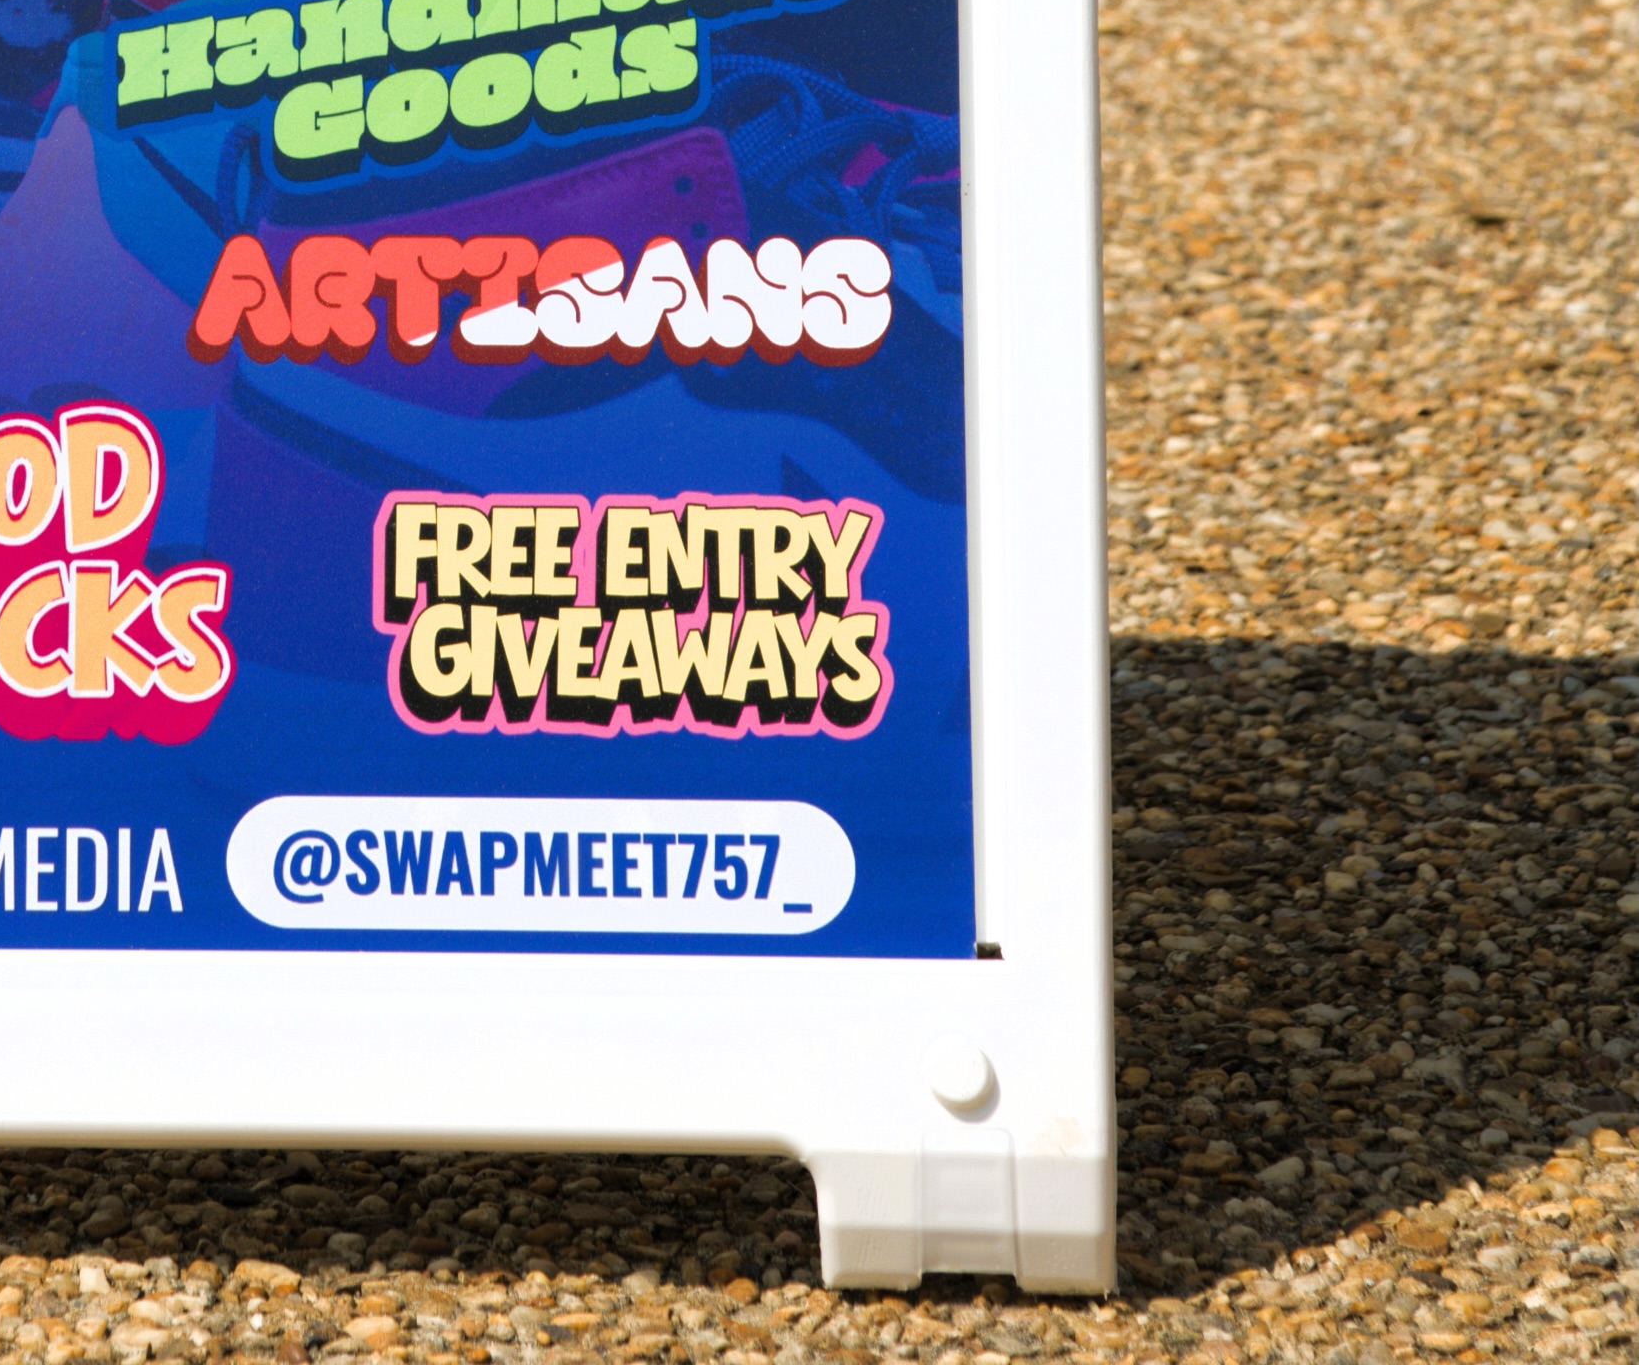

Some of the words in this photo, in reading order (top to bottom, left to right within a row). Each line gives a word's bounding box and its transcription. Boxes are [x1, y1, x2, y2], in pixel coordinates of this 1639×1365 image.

[272, 16, 699, 161] Goods
[192, 233, 893, 353] ARTISANS
[392, 501, 582, 601] FREE
[604, 502, 873, 600] ENTRY
[408, 602, 883, 703] GIVEAWAYS
[272, 828, 814, 915] @SWAPMEET757_
